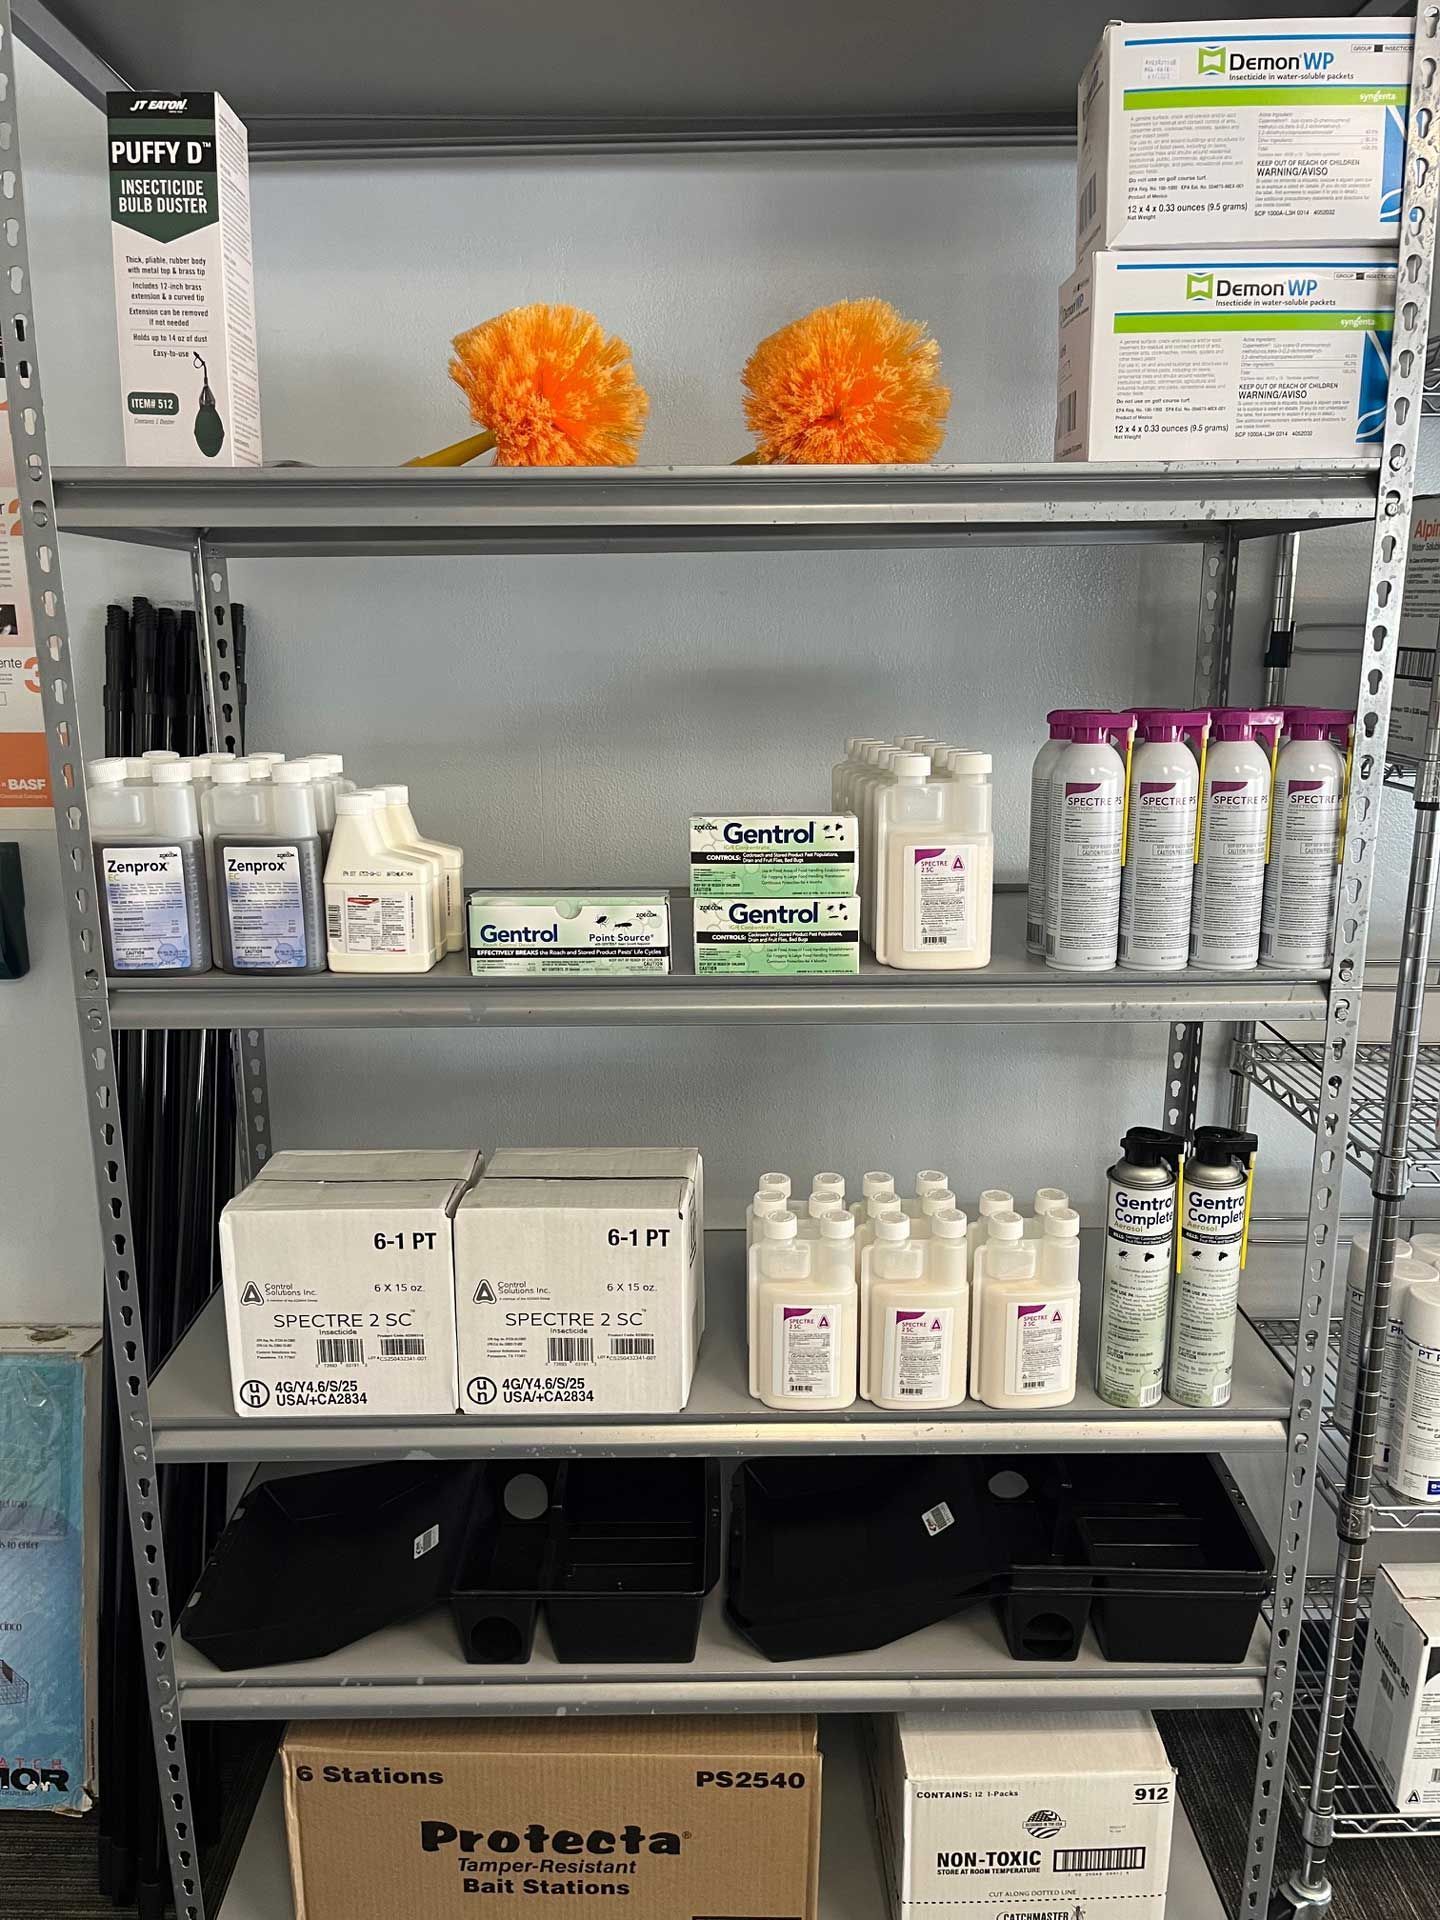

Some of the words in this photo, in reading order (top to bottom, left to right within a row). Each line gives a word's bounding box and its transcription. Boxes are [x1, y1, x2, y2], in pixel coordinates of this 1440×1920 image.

[1229, 53, 1301, 71] Demon
[1303, 52, 1335, 70] WP
[1229, 73, 1267, 81] Insecticide
[1269, 72, 1275, 80] in
[1277, 72, 1325, 80] water-soluble
[1326, 72, 1354, 81] packets
[1359, 90, 1396, 103] syngenta
[129, 100, 148, 112] JT
[111, 141, 180, 164] PUFFY
[1273, 159, 1288, 167] OUT
[1256, 166, 1329, 177] WARNING/AVISO
[120, 179, 204, 196] INSECTICIDE
[119, 197, 153, 213] BULB
[157, 197, 208, 214] DUSTER
[1128, 205, 1137, 213] 12
[1145, 204, 1150, 213] 4
[1158, 203, 1175, 213] 0.33
[1176, 202, 1206, 212] ounces
[1207, 201, 1221, 212] (9.5
[1222, 201, 1248, 213] grams)
[125, 255, 144, 264] Thick,
[145, 256, 168, 265] pliable,
[168, 256, 190, 265] rubber
[190, 257, 206, 266] body
[132, 281, 159, 290] Includes
[160, 282, 184, 290] 12-inch
[184, 283, 202, 291] brass
[1216, 280, 1284, 297] Demon
[1287, 279, 1318, 296] WP
[1215, 299, 1252, 307] Insecticide
[1261, 298, 1308, 307] water-soluble
[1309, 299, 1336, 307] packets
[129, 307, 159, 316] Extension
[181, 309, 209, 317] removed
[1340, 315, 1375, 328] syngenta
[152, 349, 189, 358] Easy-to-use
[1238, 390, 1308, 400] WARNING/AVISO
[158, 399, 174, 410] 512
[7, 778, 46, 791] BASF
[1067, 796, 1112, 807] SPECTRE
[1142, 796, 1188, 806] SPECTRE
[1213, 795, 1258, 805] SPECTRE
[723, 821, 815, 844] Gentrol
[107, 860, 168, 876] Zenprox
[227, 858, 286, 875] Zenprox
[107, 873, 121, 882] EC
[228, 872, 241, 880] EC
[728, 901, 819, 924] Gentrol
[480, 923, 559, 943] Gentrol
[589, 933, 615, 942] Point
[1113, 1220, 1144, 1233] Aerosol
[1186, 1220, 1218, 1233] Aerosol
[373, 1232, 404, 1250] 6-1
[412, 1232, 437, 1250] PT
[607, 1228, 638, 1247] 6-1
[646, 1229, 671, 1247] PT
[264, 1282, 293, 1291] Control
[374, 1283, 381, 1293] 6
[384, 1284, 392, 1292] X
[396, 1283, 408, 1292] 15
[410, 1285, 425, 1293] oz.
[497, 1280, 527, 1289] Control
[498, 1286, 535, 1295] Solutions
[536, 1286, 551, 1294] Inc.
[606, 1283, 614, 1292] 6
[616, 1283, 624, 1292] X
[627, 1283, 640, 1292] 15
[642, 1284, 658, 1292] oz.
[265, 1288, 301, 1296] Solutions
[1351, 1290, 1363, 1301] PT
[273, 1313, 364, 1328] SPECTRE
[369, 1313, 380, 1327] 2
[505, 1312, 595, 1327] SPECTRE
[600, 1313, 610, 1327] 2
[550, 1327, 588, 1335] Insecticide
[1418, 1349, 1434, 1360] PT
[275, 1380, 358, 1393] 4G/Y4.6/S/25
[502, 1377, 585, 1391] 4G/Y4.6/S/25
[276, 1392, 368, 1406] USA/+CA2834
[503, 1389, 594, 1403] USA/+CA2834
[17, 1540, 40, 1550] enter
[296, 1765, 314, 1782] 6
[323, 1766, 444, 1785] Stations
[695, 1770, 806, 1790] PS2540
[916, 1790, 972, 1799] CONTAINS:
[1134, 1787, 1169, 1801] 912
[936, 1850, 1042, 1868] NON-TOXIC
[456, 1857, 637, 1876] Tamper-Resistant
[937, 1868, 960, 1876] STORE
[969, 1867, 991, 1875] ROOM
[991, 1867, 1041, 1875] TEMPERATURE
[463, 1878, 515, 1894] Bait
[522, 1878, 630, 1896] Stations
[1005, 1890, 1030, 1898] ALONG
[1031, 1889, 1060, 1897] DOTTED
